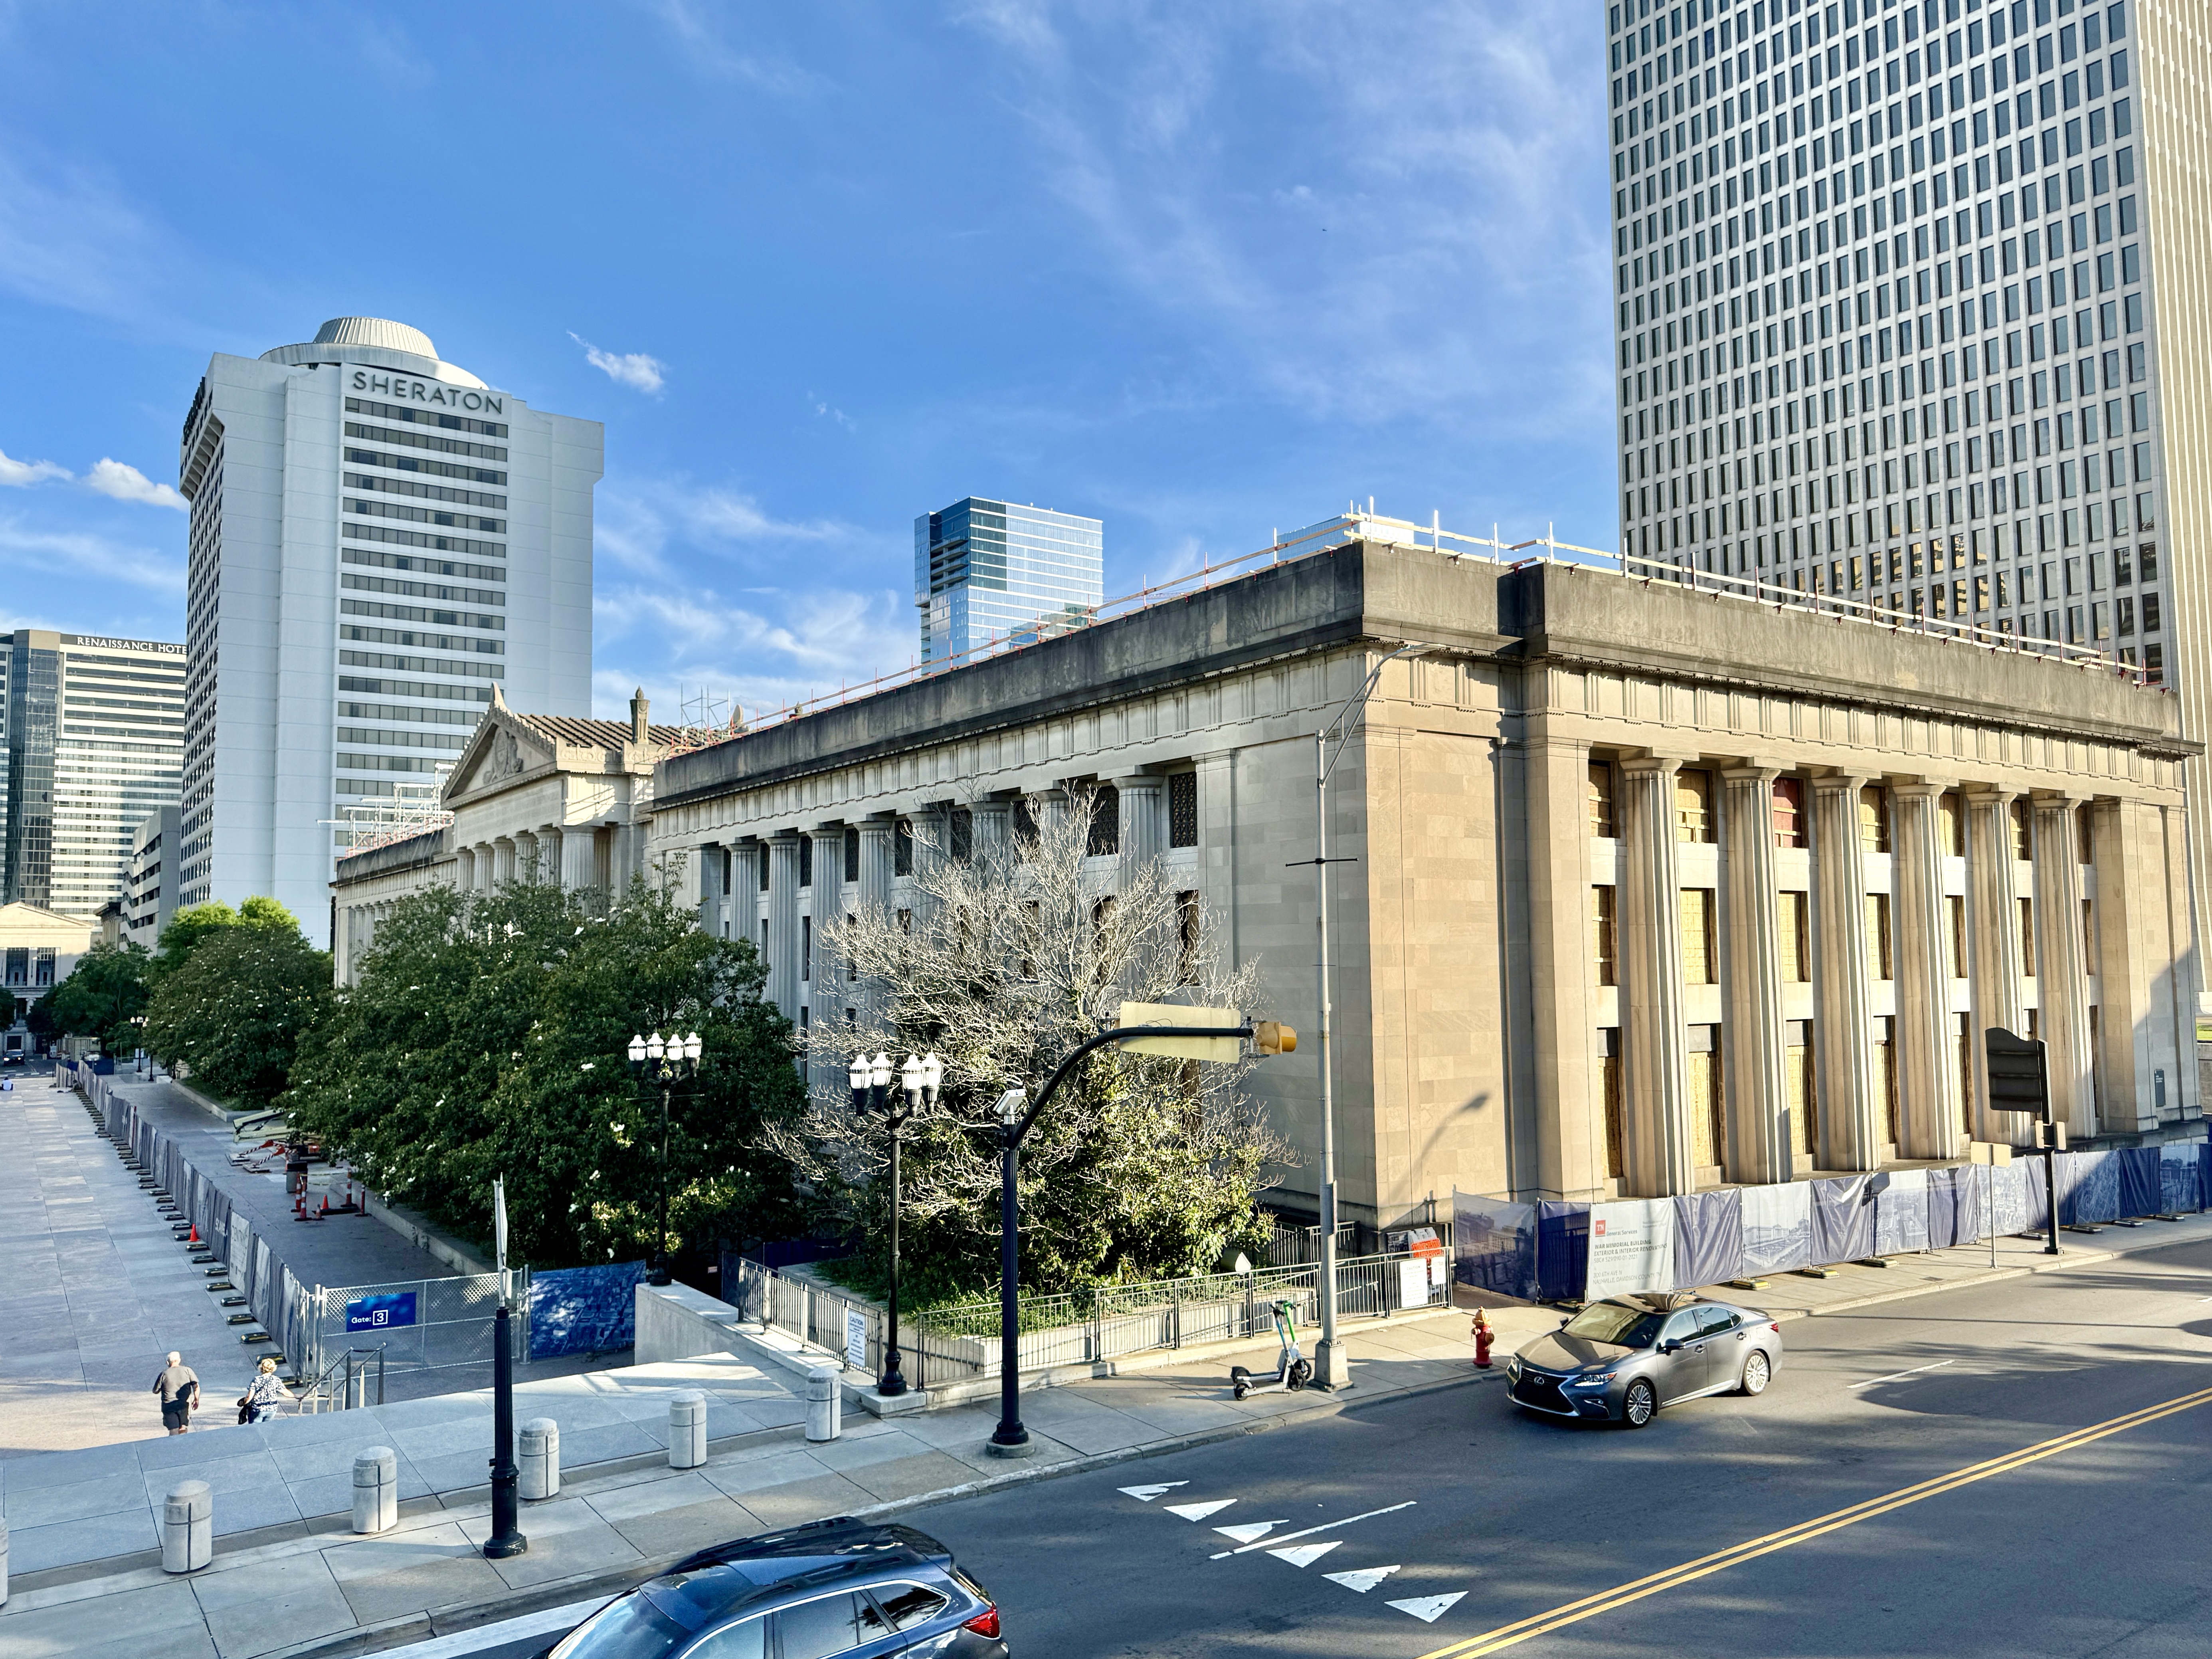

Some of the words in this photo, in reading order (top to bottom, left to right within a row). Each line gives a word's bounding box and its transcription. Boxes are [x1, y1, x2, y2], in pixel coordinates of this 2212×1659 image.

[353, 372, 502, 415] SHERATON
[77, 636, 153, 651] RENAISSANCE
[158, 644, 187, 654] HOTE
[377, 1313, 384, 1322] 3
